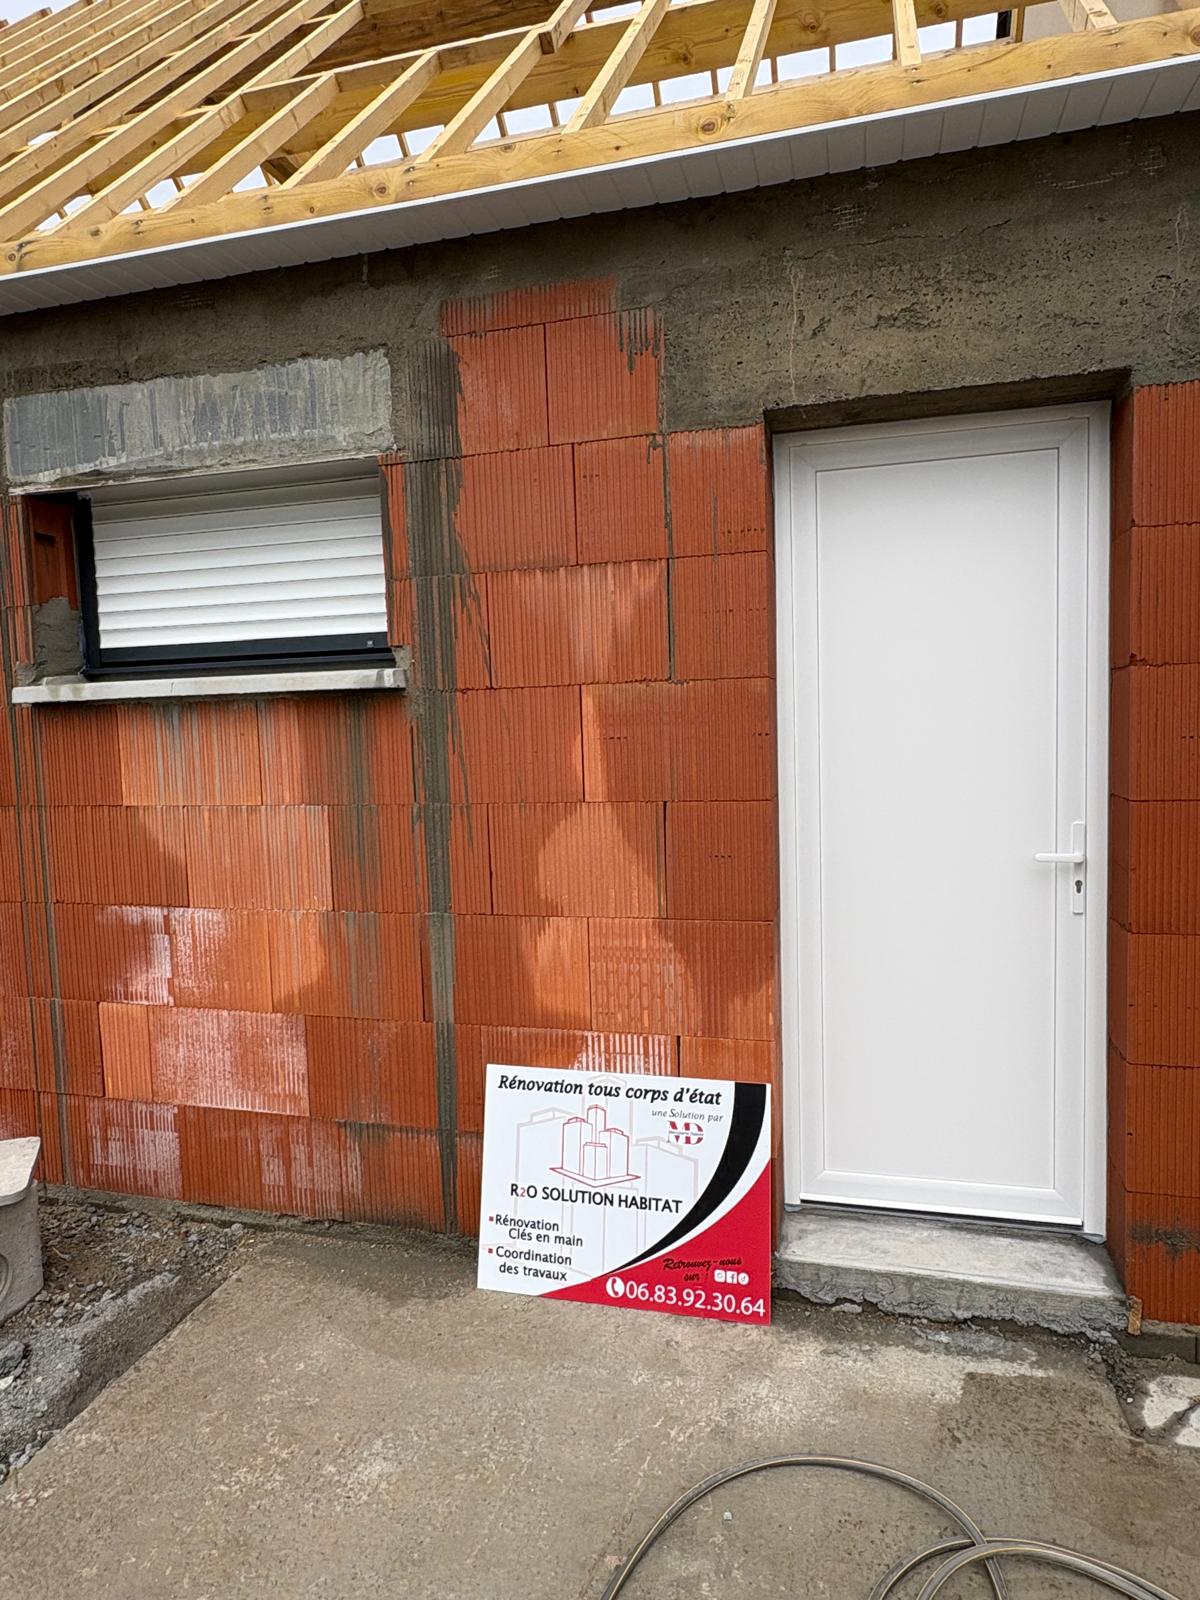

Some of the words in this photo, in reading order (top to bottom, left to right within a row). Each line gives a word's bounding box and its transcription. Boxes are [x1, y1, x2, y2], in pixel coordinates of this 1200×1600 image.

[498, 1075, 583, 1095] Rénovation
[588, 1083, 620, 1098] tous
[625, 1089, 668, 1104] corps
[651, 1109, 667, 1118] une
[668, 1108, 705, 1121] Solution
[707, 1113, 724, 1123] par
[510, 1184, 538, 1199] R2O
[541, 1188, 614, 1207] SOLUTION
[618, 1198, 683, 1214] HABITAT
[495, 1214, 559, 1232] Rénovation
[508, 1228, 532, 1241] Clés
[535, 1234, 549, 1243] en
[554, 1235, 583, 1247] main
[496, 1247, 572, 1266] Coordination
[499, 1262, 519, 1276] des
[523, 1266, 567, 1282] travaux
[625, 1280, 766, 1317] 06.83.92.30.64
